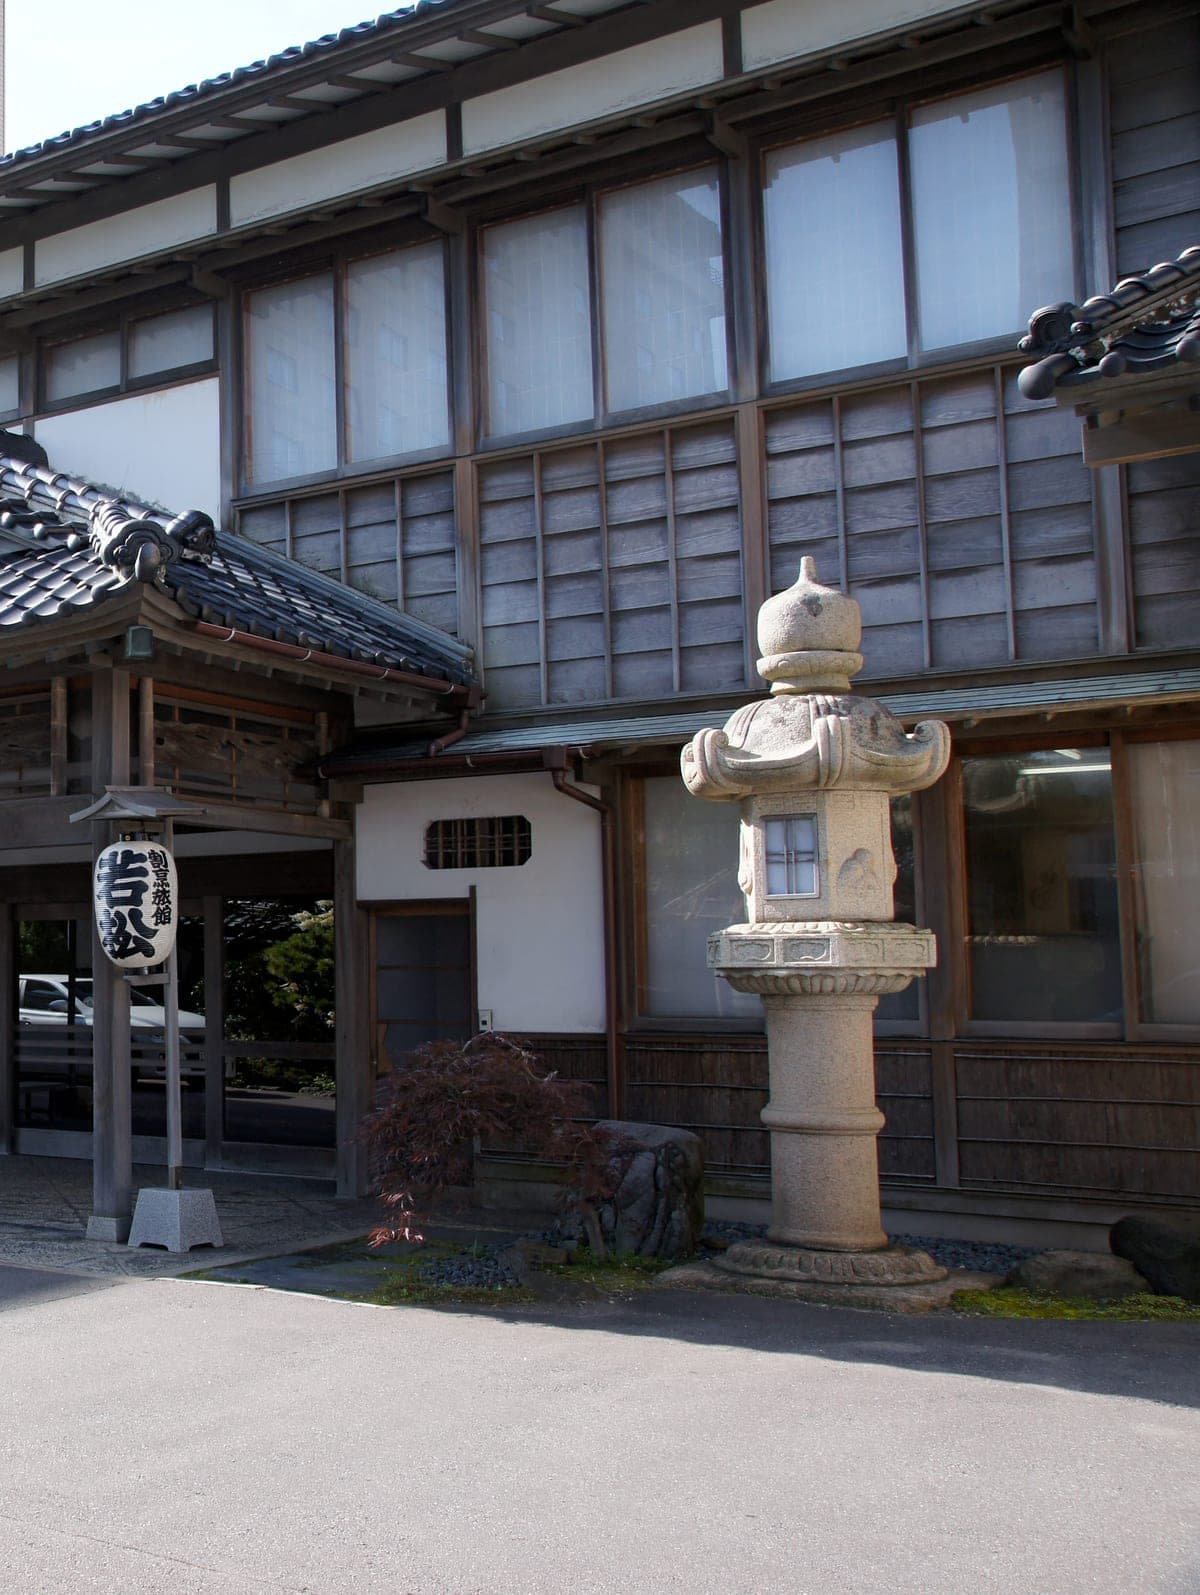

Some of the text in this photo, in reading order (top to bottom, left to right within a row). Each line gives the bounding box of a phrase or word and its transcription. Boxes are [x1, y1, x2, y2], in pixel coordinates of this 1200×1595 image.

[97, 849, 159, 959] 若松
[148, 849, 172, 926] 割烹旅館
